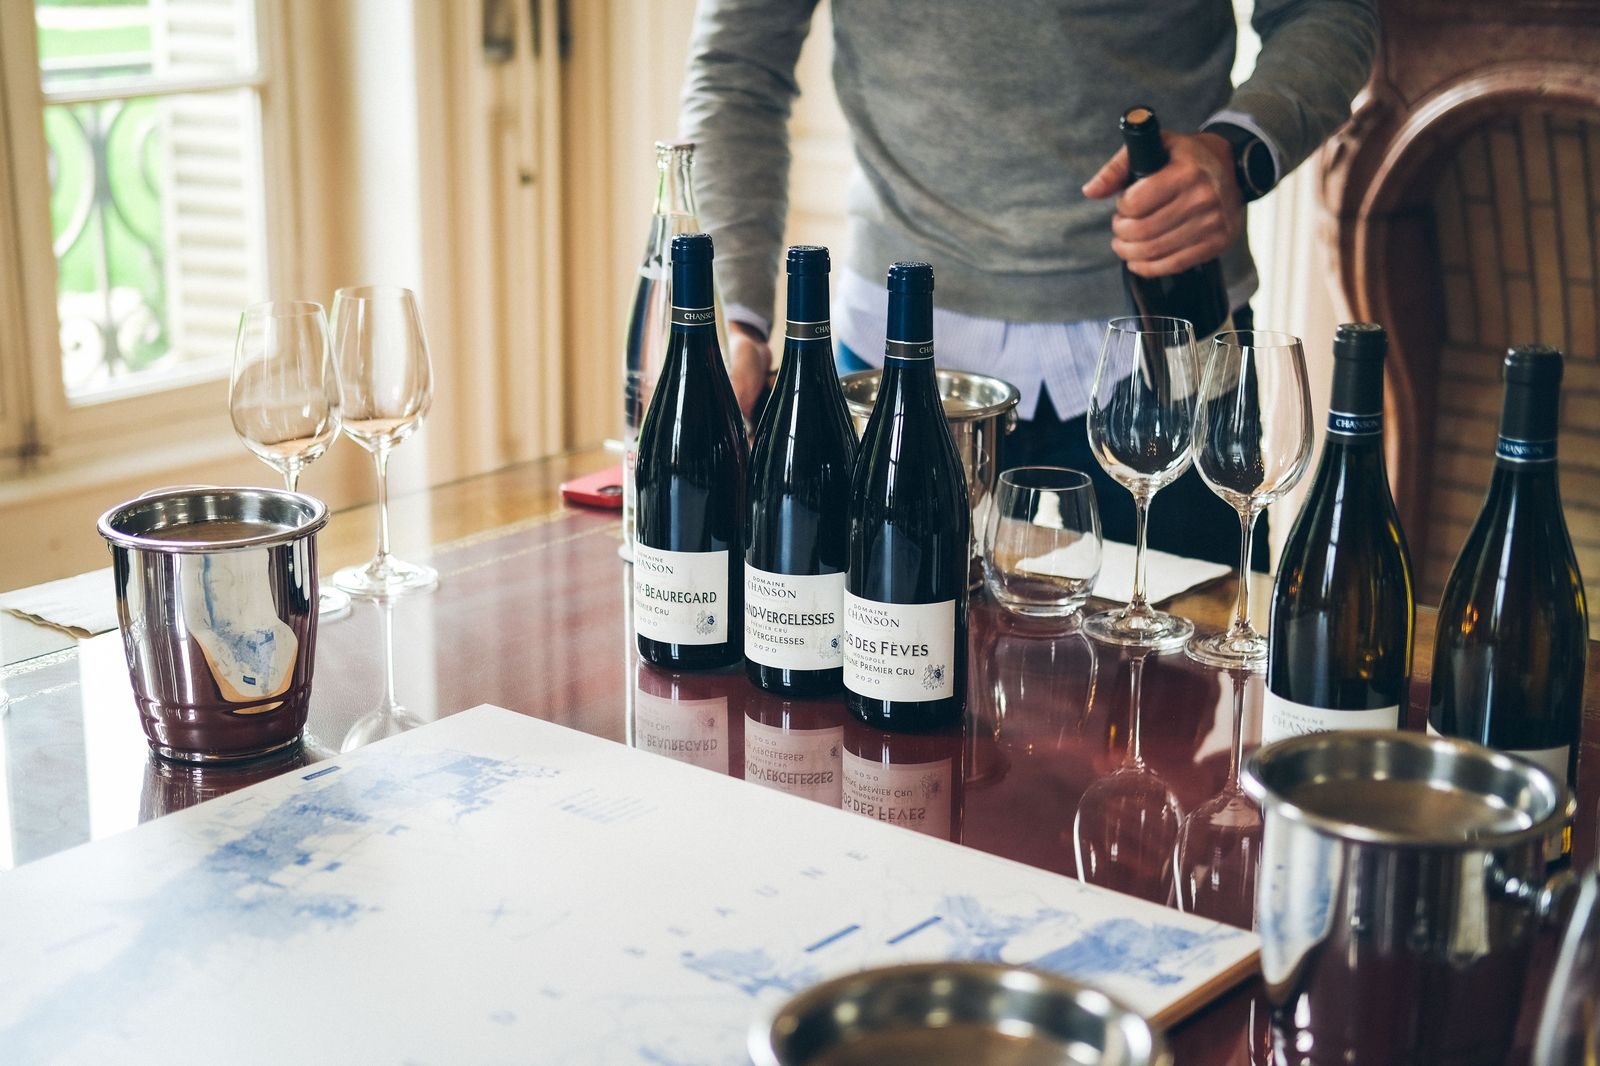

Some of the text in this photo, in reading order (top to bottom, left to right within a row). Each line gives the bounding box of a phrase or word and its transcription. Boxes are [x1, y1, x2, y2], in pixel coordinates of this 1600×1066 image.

[684, 312, 714, 321] CHANSO
[636, 556, 674, 575] HANSON
[748, 580, 797, 599] CHANSON
[753, 576, 785, 588] DOMAINE
[654, 606, 670, 616] CRU
[848, 608, 900, 628] CHANSON
[854, 604, 888, 617] DOMAINE
[753, 628, 805, 646] VERGELESSES
[754, 642, 777, 654] 2020
[855, 636, 877, 654] DES
[881, 641, 929, 657] FÈVES
[860, 661, 893, 675] PREMIER
[895, 667, 915, 676] CRU
[855, 673, 880, 685] 2020
[1272, 714, 1331, 736] CHANSO
